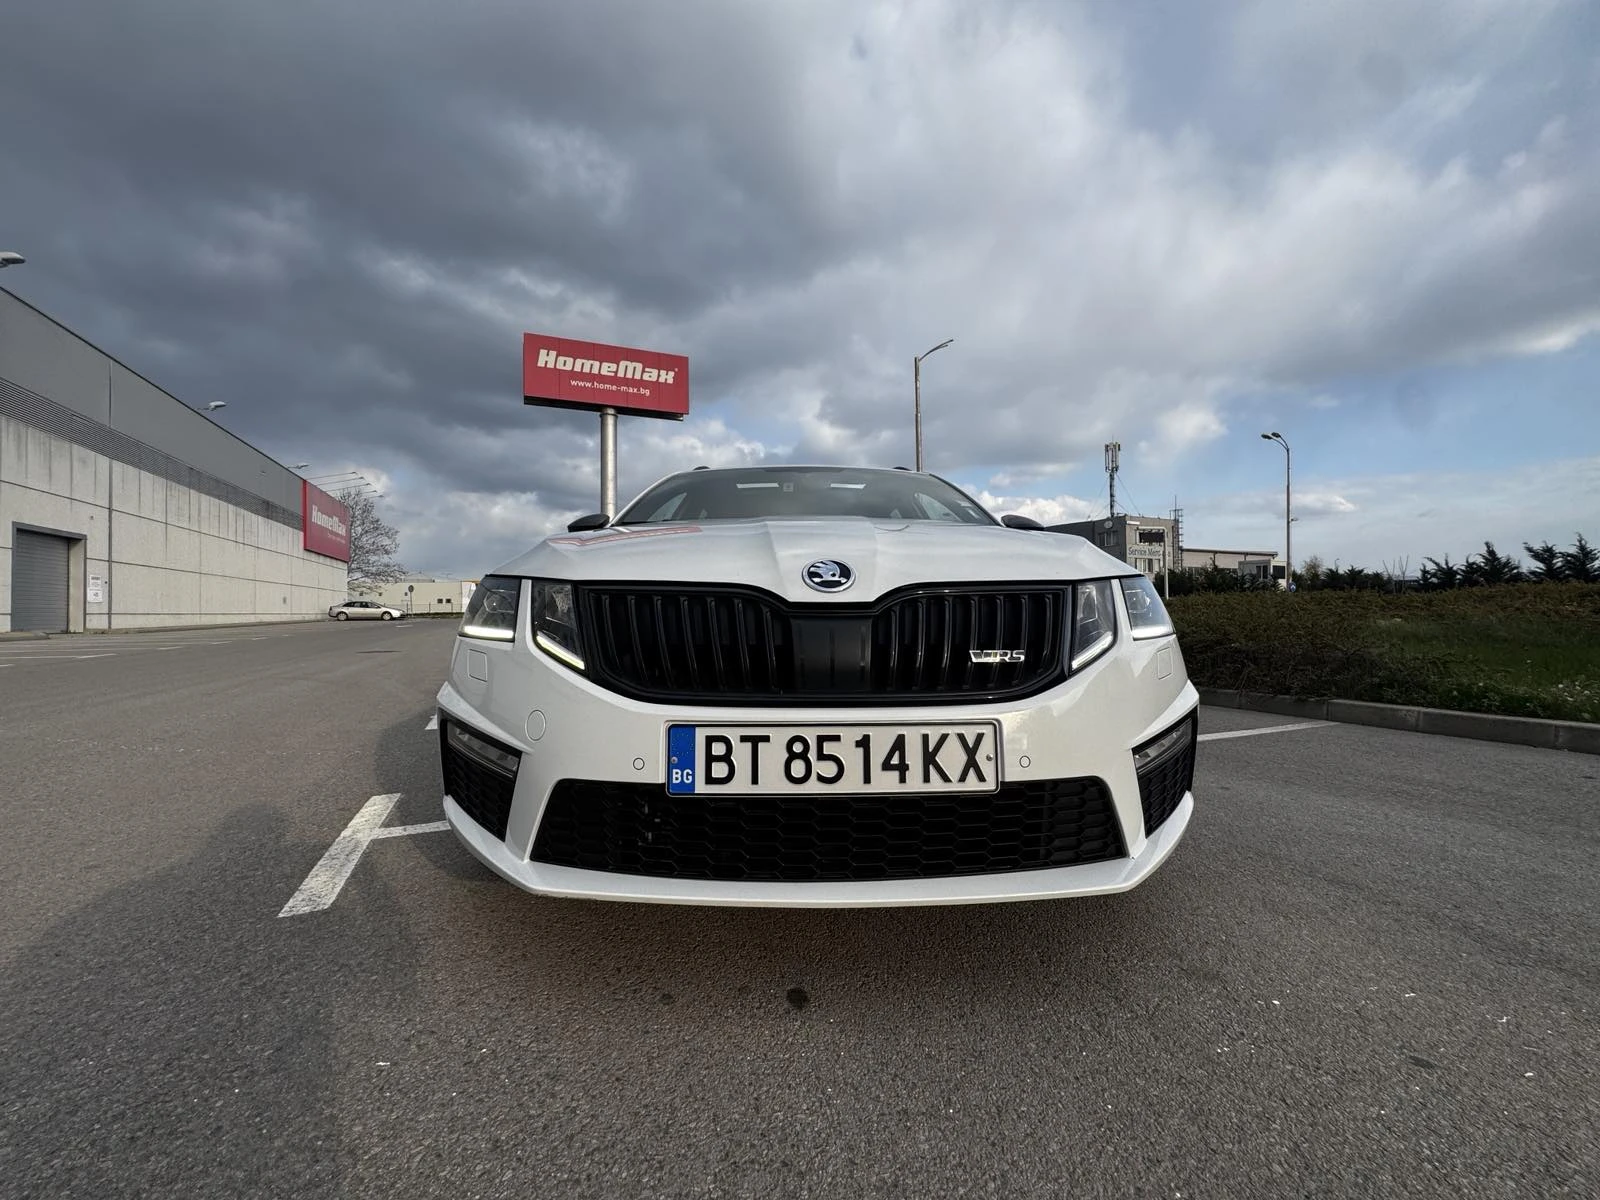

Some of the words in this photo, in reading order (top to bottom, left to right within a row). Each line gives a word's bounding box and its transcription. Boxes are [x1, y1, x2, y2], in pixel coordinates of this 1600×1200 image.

[537, 349, 675, 384] HomeMax
[570, 378, 650, 396] www.home-max.bg
[672, 769, 693, 784] BG
